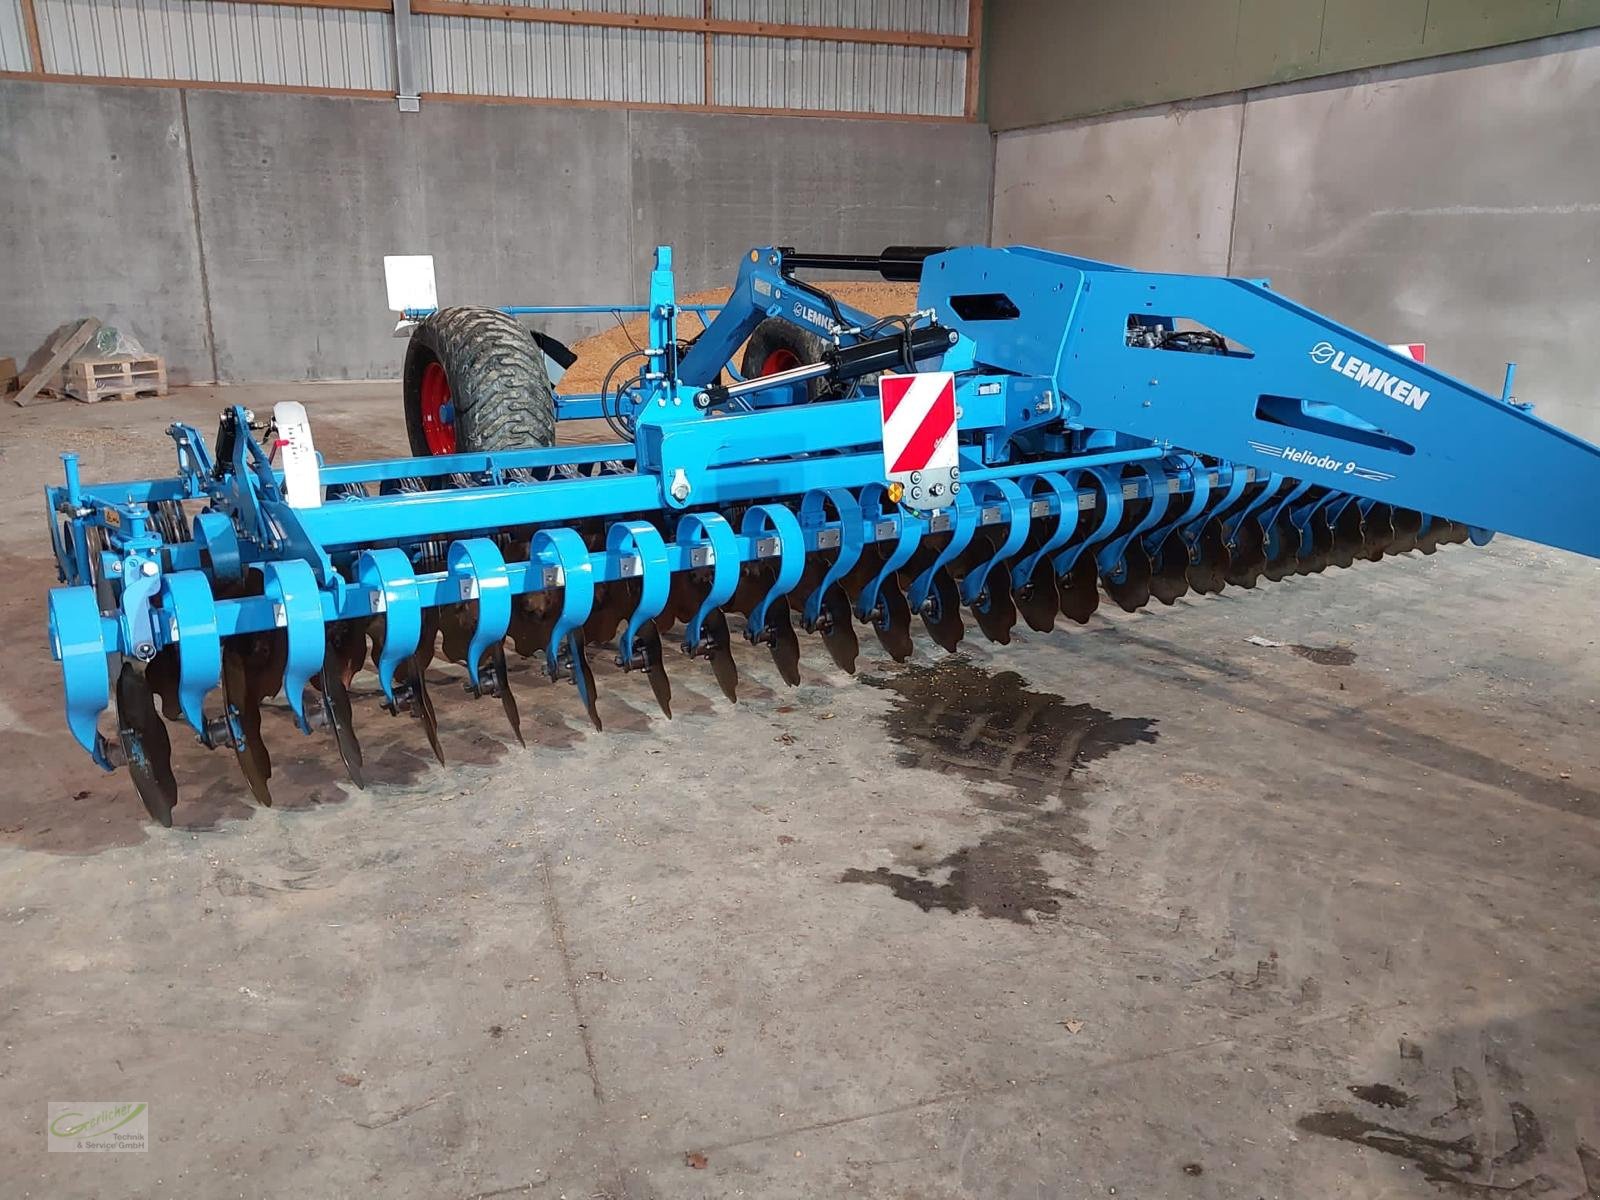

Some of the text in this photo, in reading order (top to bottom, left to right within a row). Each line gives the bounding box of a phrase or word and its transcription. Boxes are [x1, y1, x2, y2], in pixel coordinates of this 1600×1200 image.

[802, 306, 835, 330] LEMKE
[1331, 351, 1430, 411] LEMKEN
[1281, 446, 1356, 474] Heliodor 9
